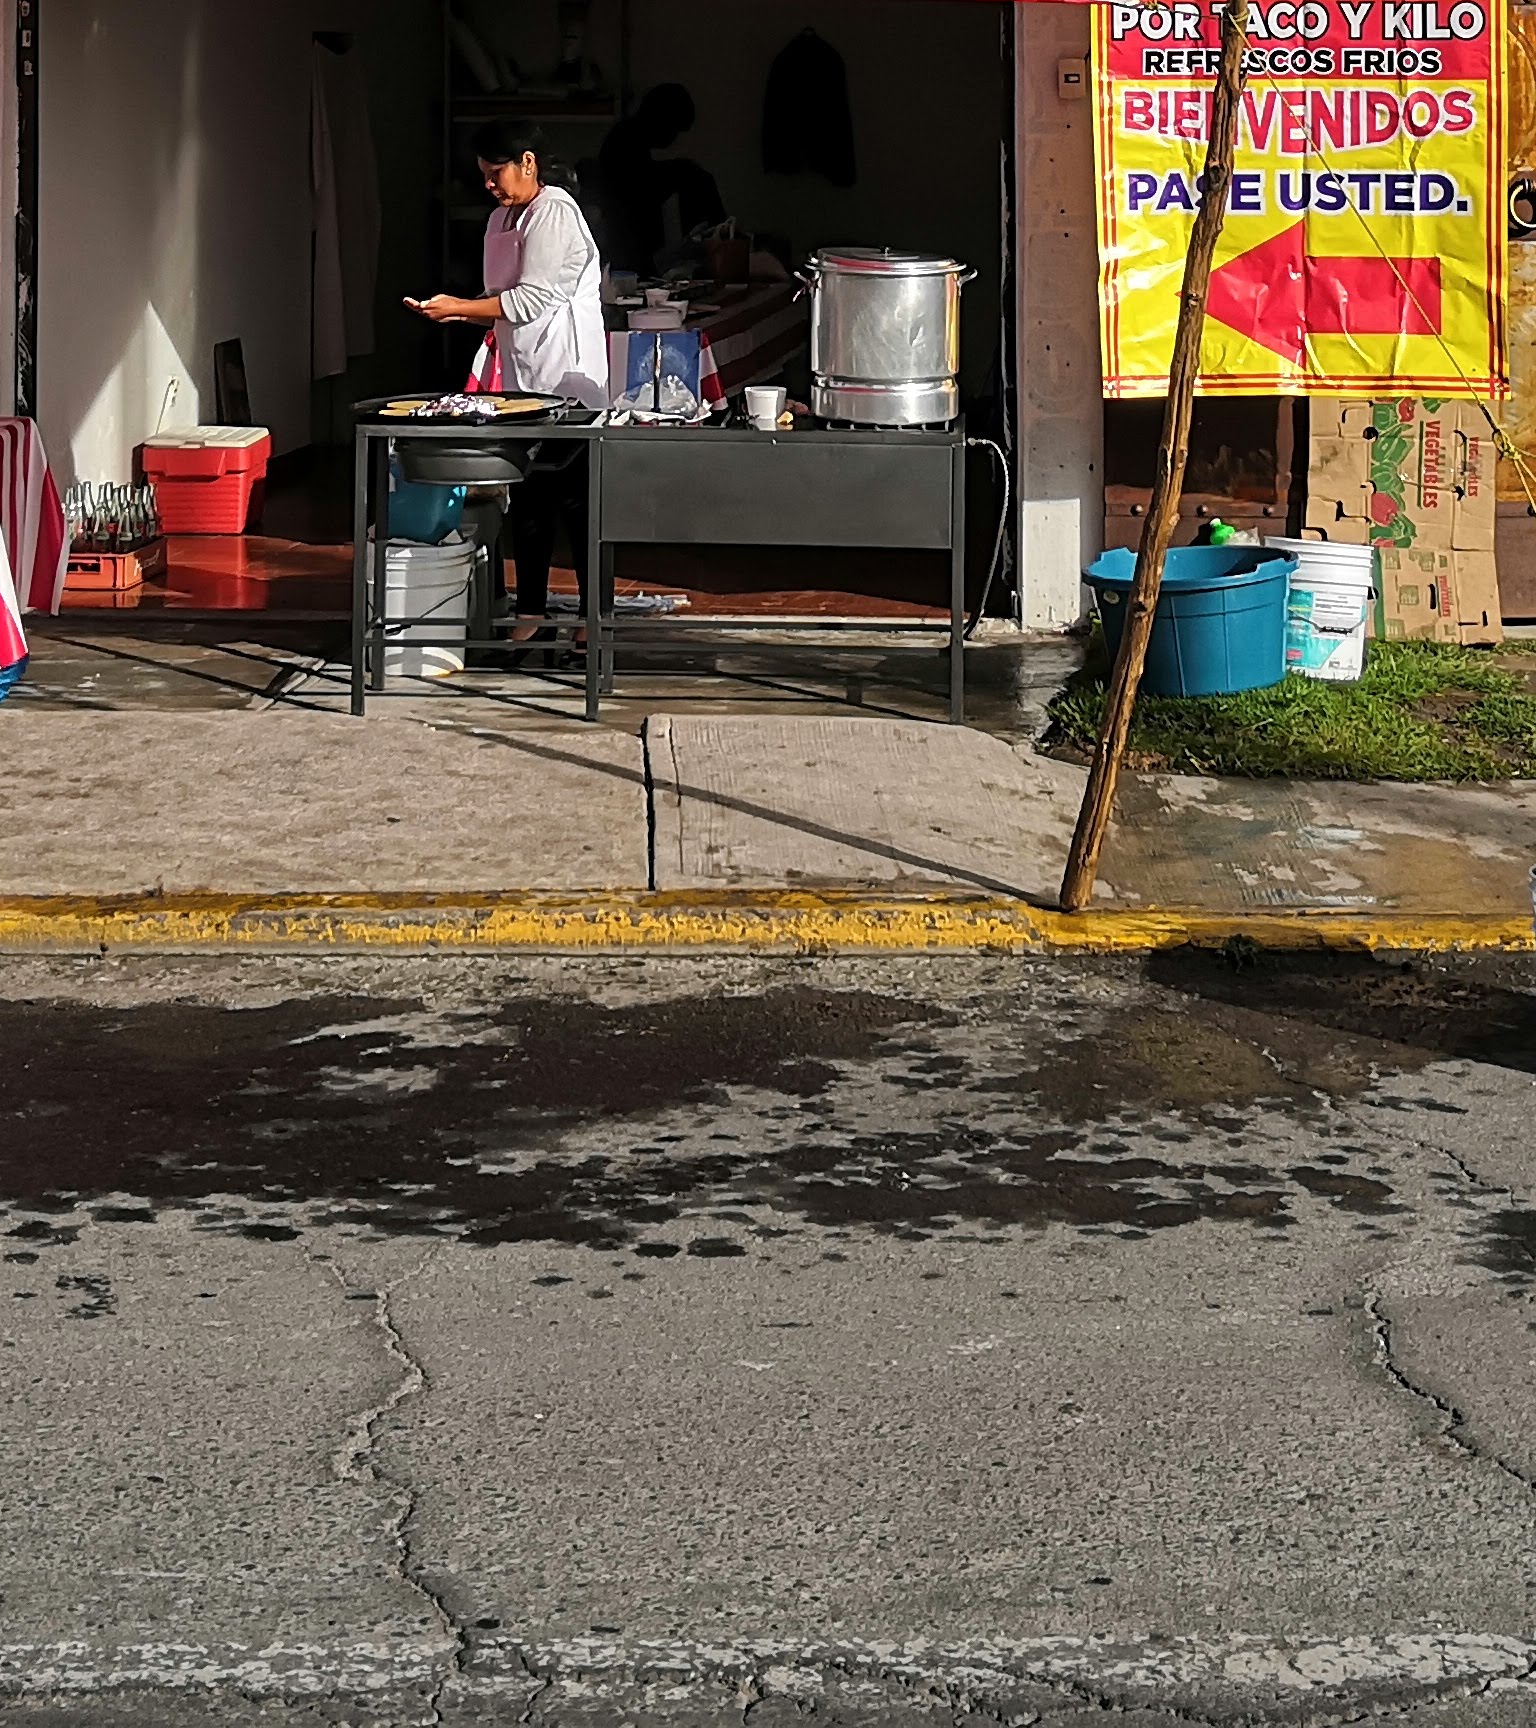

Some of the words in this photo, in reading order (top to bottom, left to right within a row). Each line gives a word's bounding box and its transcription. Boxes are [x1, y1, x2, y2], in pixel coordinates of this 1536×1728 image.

[1113, 2, 1200, 40] POR
[1339, 2, 1375, 40] Y
[1386, 2, 1484, 40] KILO
[1144, 49, 1332, 74] REFRSCOS
[1343, 49, 1441, 74] FRIOS
[1127, 172, 1261, 211] PAE
[1279, 172, 1469, 212] USTED.
[1422, 420, 1441, 509] VEGETABLES
